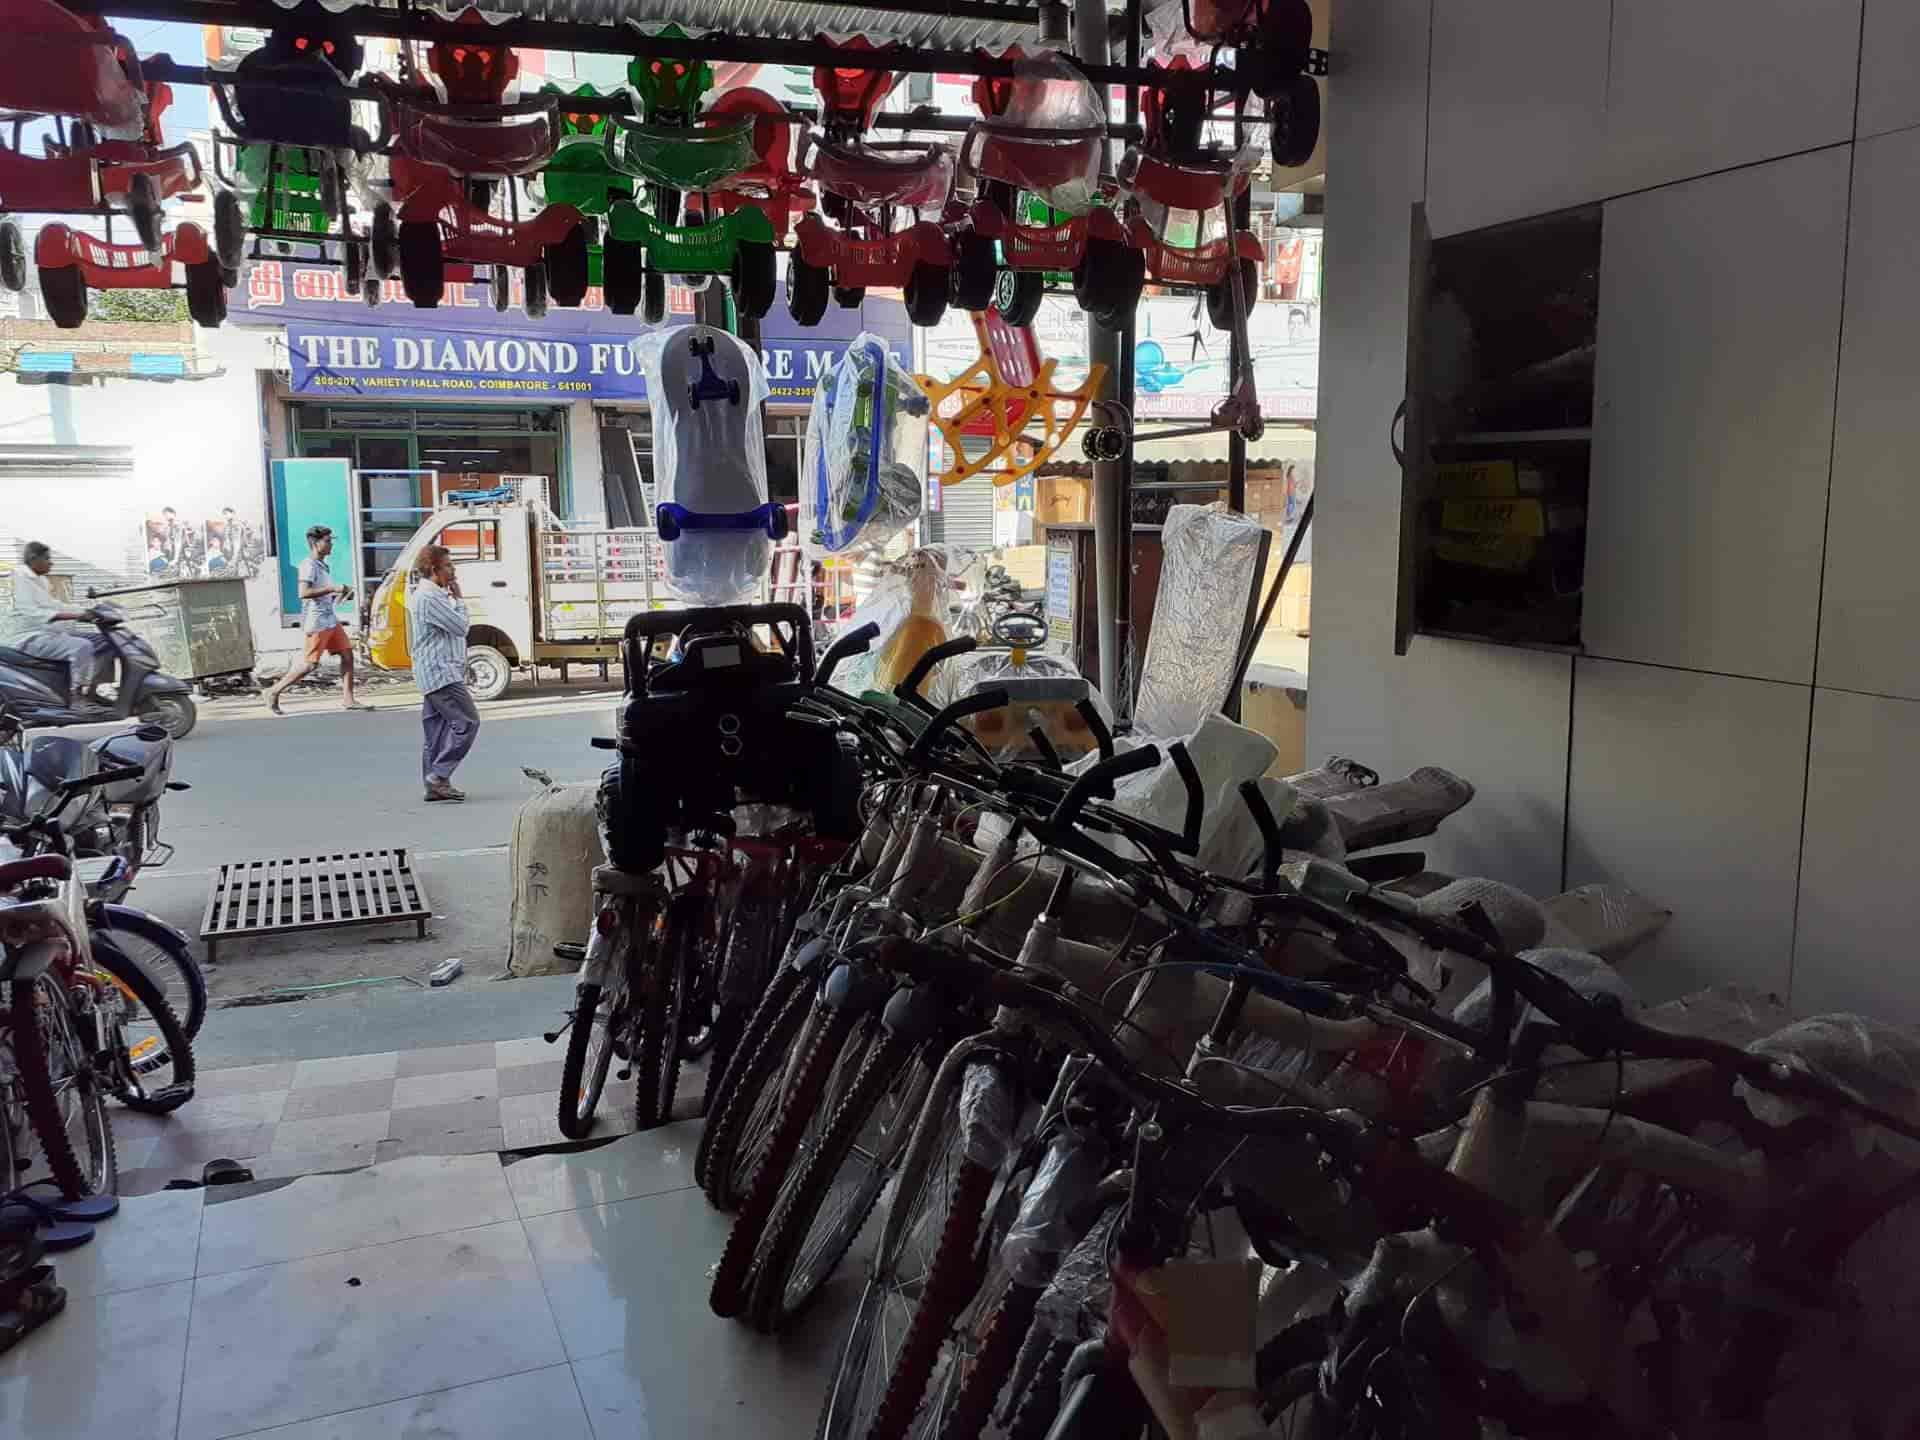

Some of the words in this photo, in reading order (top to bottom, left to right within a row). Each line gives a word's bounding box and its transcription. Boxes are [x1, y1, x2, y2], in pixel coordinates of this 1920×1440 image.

[299, 335, 382, 369] THE
[392, 338, 579, 374] DIAMOND
[362, 377, 408, 388] VARIETY
[411, 377, 441, 388] HALL
[479, 379, 549, 391] COIMBATORE
